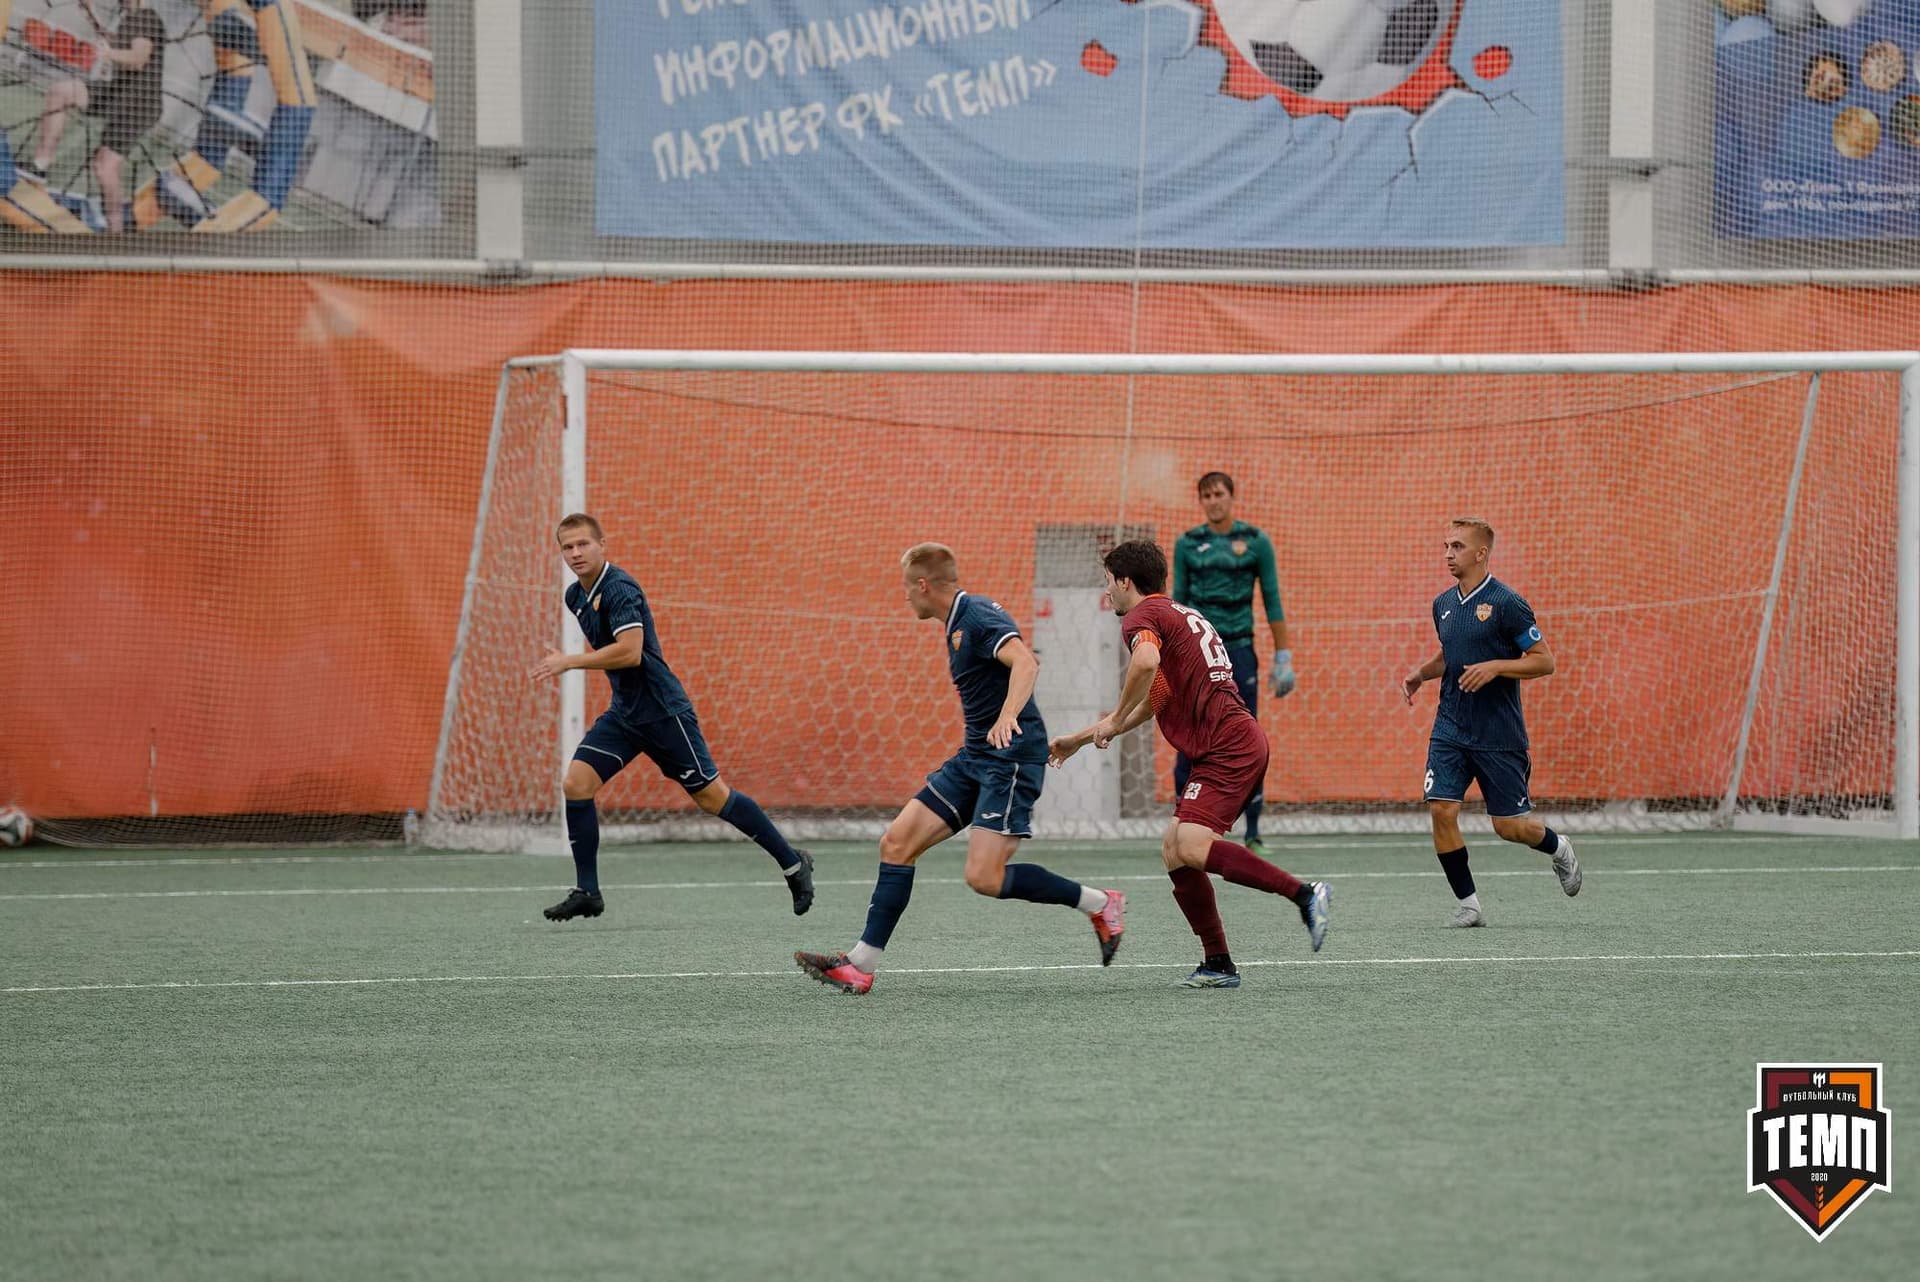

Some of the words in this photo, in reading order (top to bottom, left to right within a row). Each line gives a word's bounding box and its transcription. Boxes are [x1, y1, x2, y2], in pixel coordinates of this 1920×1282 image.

[652, 102, 826, 182] ПАРТНЕР
[837, 85, 903, 140] ФК
[914, 55, 1057, 121] «ТЕМП»
[1184, 782, 1202, 800] 23
